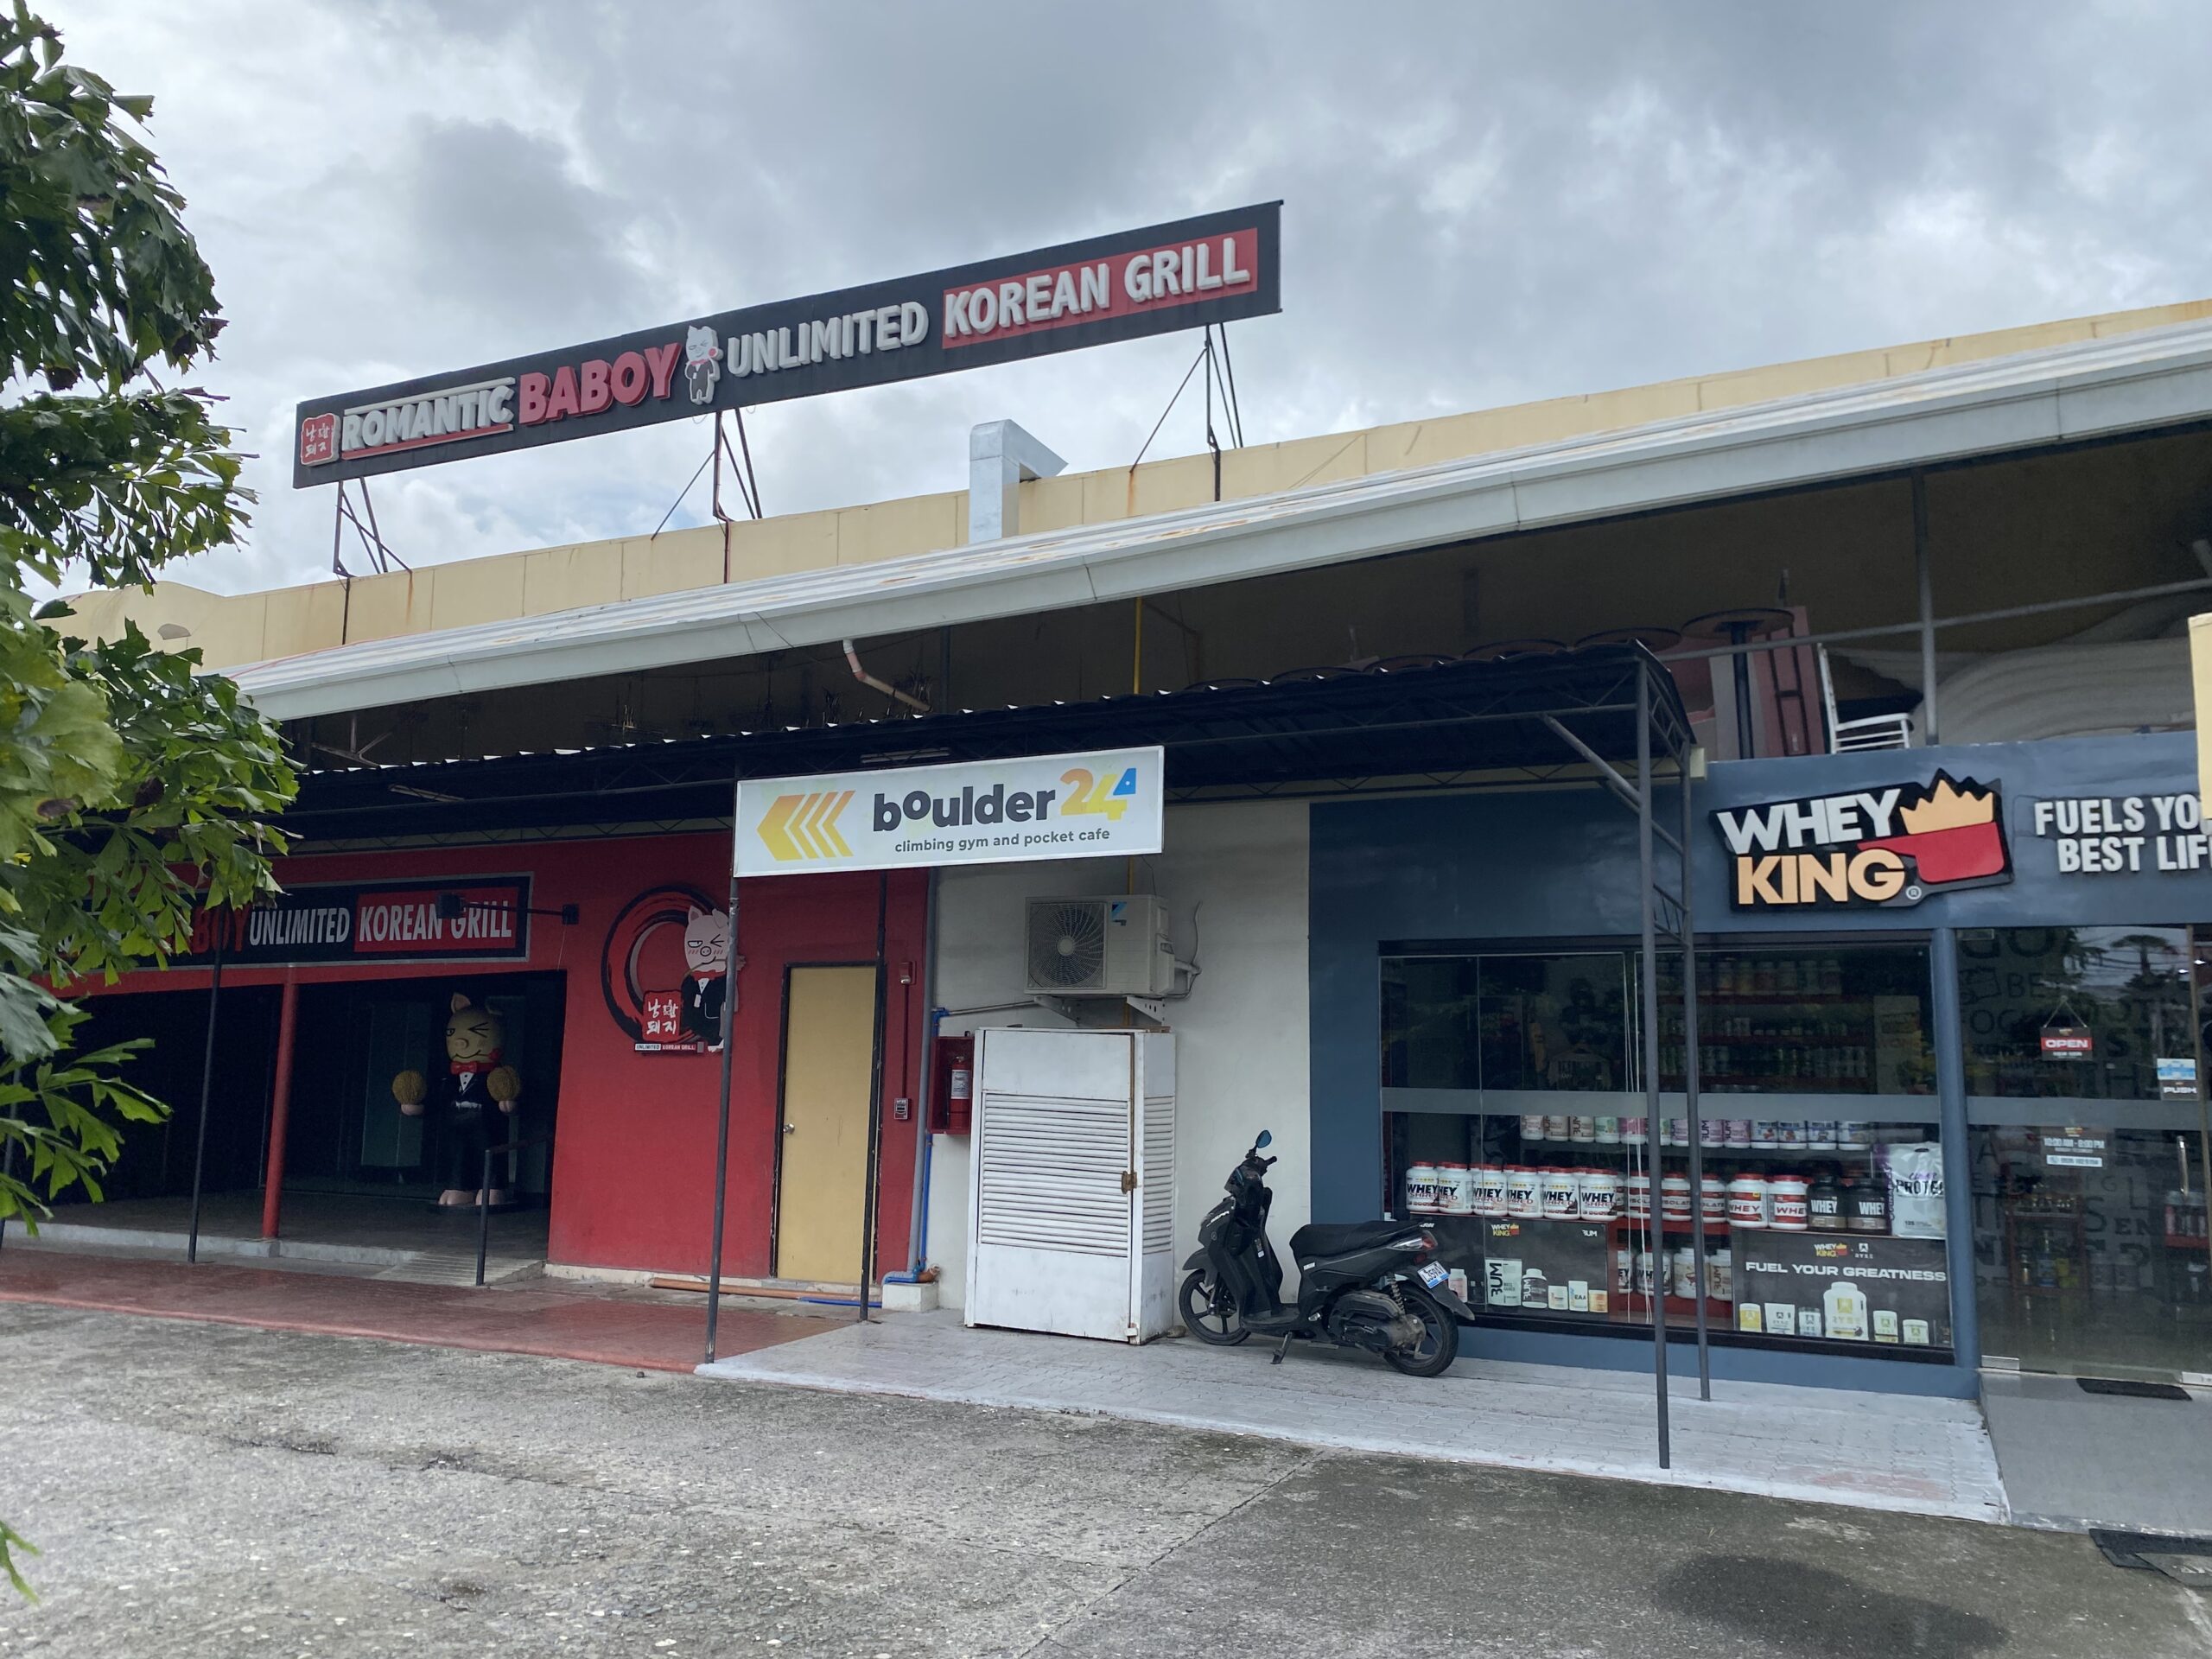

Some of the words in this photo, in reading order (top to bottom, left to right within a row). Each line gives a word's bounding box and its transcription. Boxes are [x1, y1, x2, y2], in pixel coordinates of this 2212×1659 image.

[342, 386, 515, 452] ROMANTIC
[518, 343, 681, 425] BABOY
[727, 301, 929, 378] UNLIMITED
[944, 263, 1110, 339] KOREAN
[1123, 237, 1251, 303] GRILL
[1717, 787, 1902, 855] WHEY
[2034, 797, 2146, 836] FUELS
[2152, 793, 2212, 831] YO
[894, 839, 954, 853] climbing
[958, 836, 988, 851] gym
[993, 833, 1020, 846] and
[1023, 830, 1074, 844] pocket
[1078, 827, 1110, 841] cafe
[2056, 836, 2145, 872] BEST
[2156, 835, 2212, 871] LIF
[1737, 849, 1906, 905] KING
[249, 907, 351, 947] UNLIMITED
[359, 904, 443, 943] KOREAN
[450, 900, 512, 939] GRILL
[2045, 1039, 2088, 1048] OPEN
[1407, 1183, 1439, 1194] WHEY
[1438, 1185, 1458, 1196] HEY
[1509, 1189, 1533, 1200] HEY
[1581, 1192, 1615, 1203] WHEY
[1776, 1206, 1807, 1215] WHE
[1810, 1199, 1838, 1214] WHEY
[1859, 1201, 1885, 1215] WHEY
[1745, 1262, 1788, 1273] FUEL
[1791, 1264, 1839, 1276] YOUR
[1842, 1267, 1947, 1281] GREATNESS
